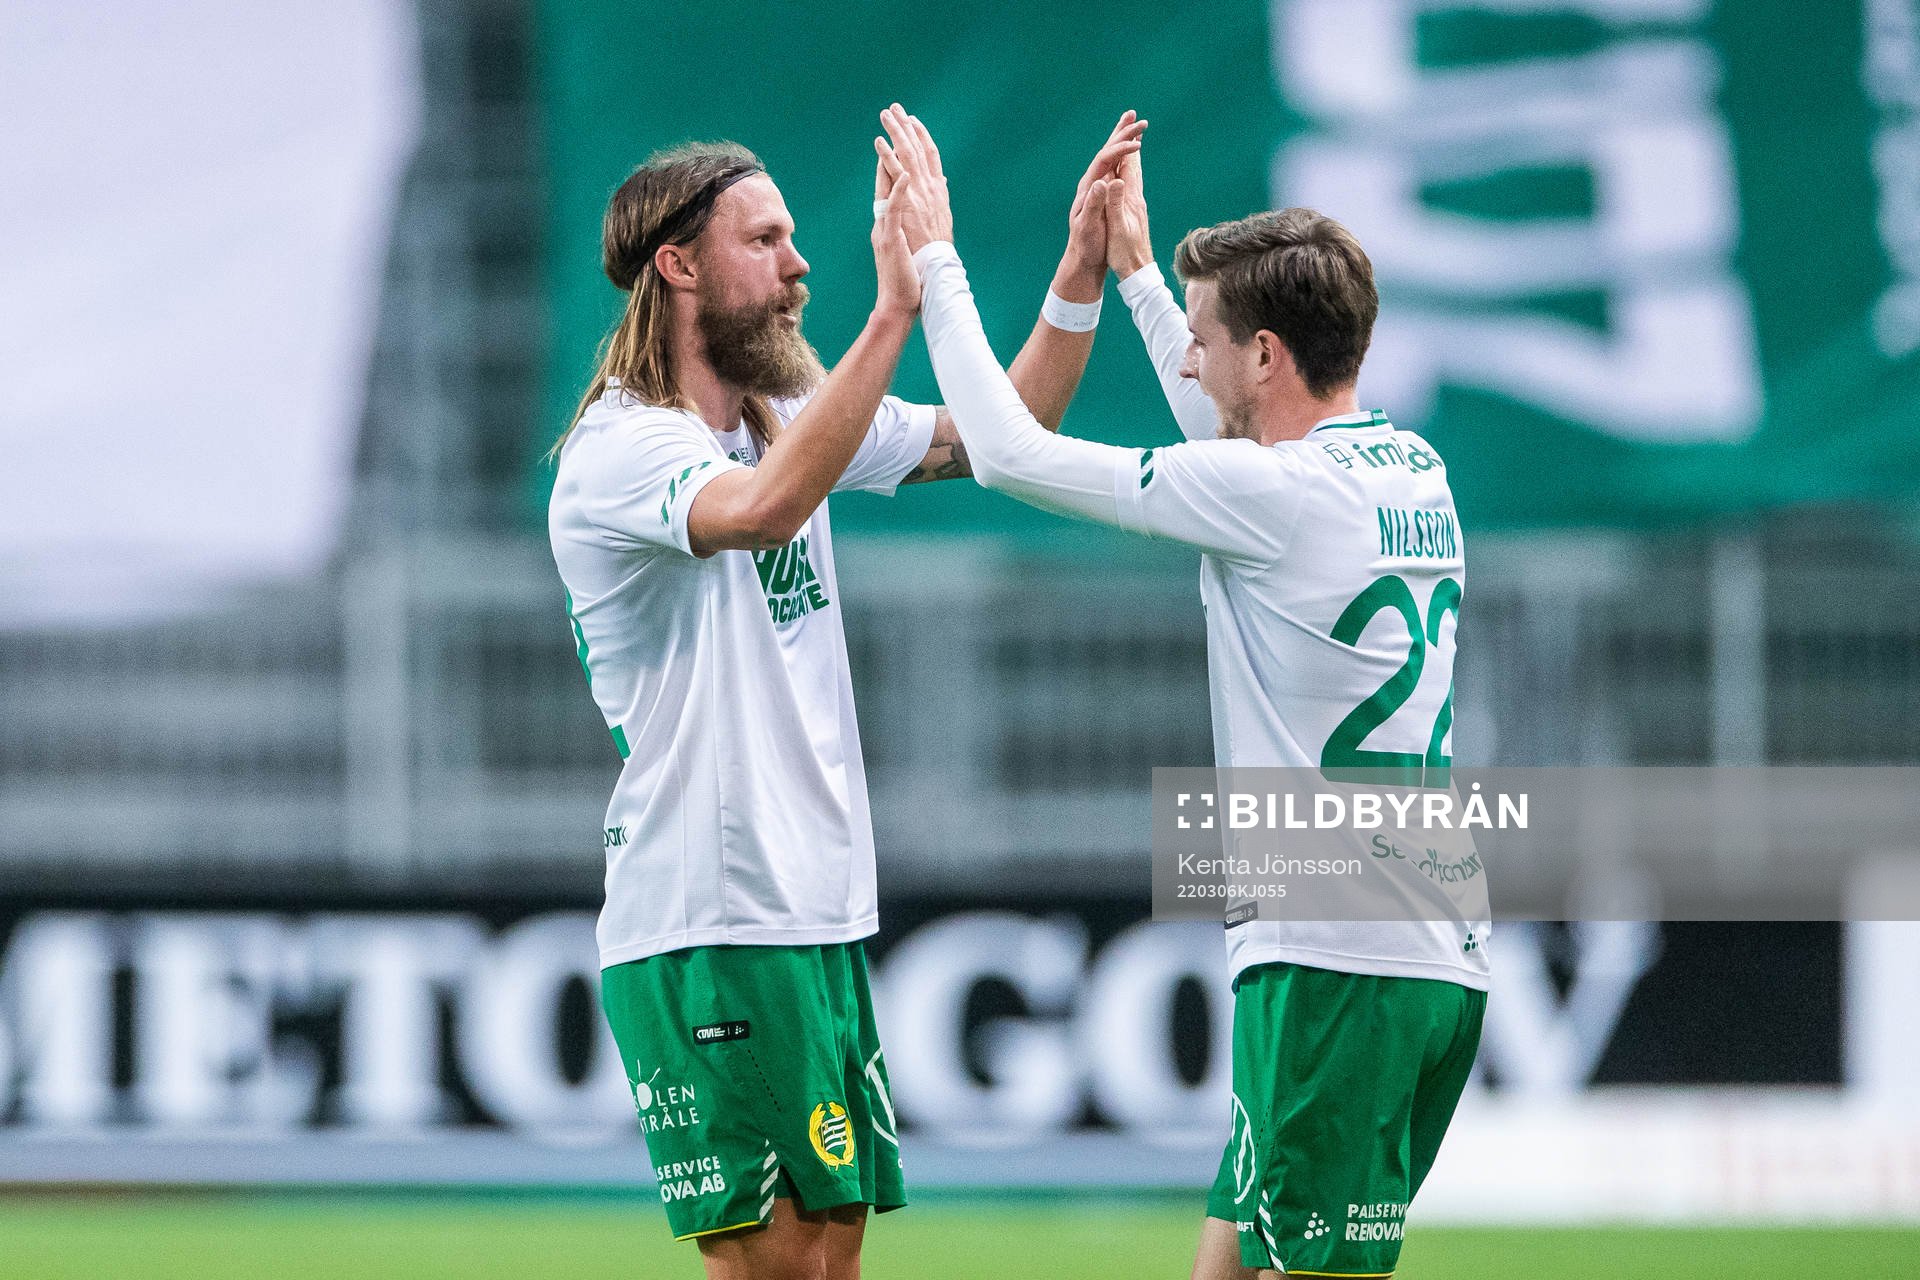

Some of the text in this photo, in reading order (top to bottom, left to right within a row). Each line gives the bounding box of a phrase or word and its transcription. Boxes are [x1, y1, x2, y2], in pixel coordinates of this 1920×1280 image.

[1377, 507, 1457, 559] NILSSON
[1320, 574, 1462, 789] 22
[656, 1156, 721, 1181] SERVICE
[700, 1173, 726, 1195] AB
